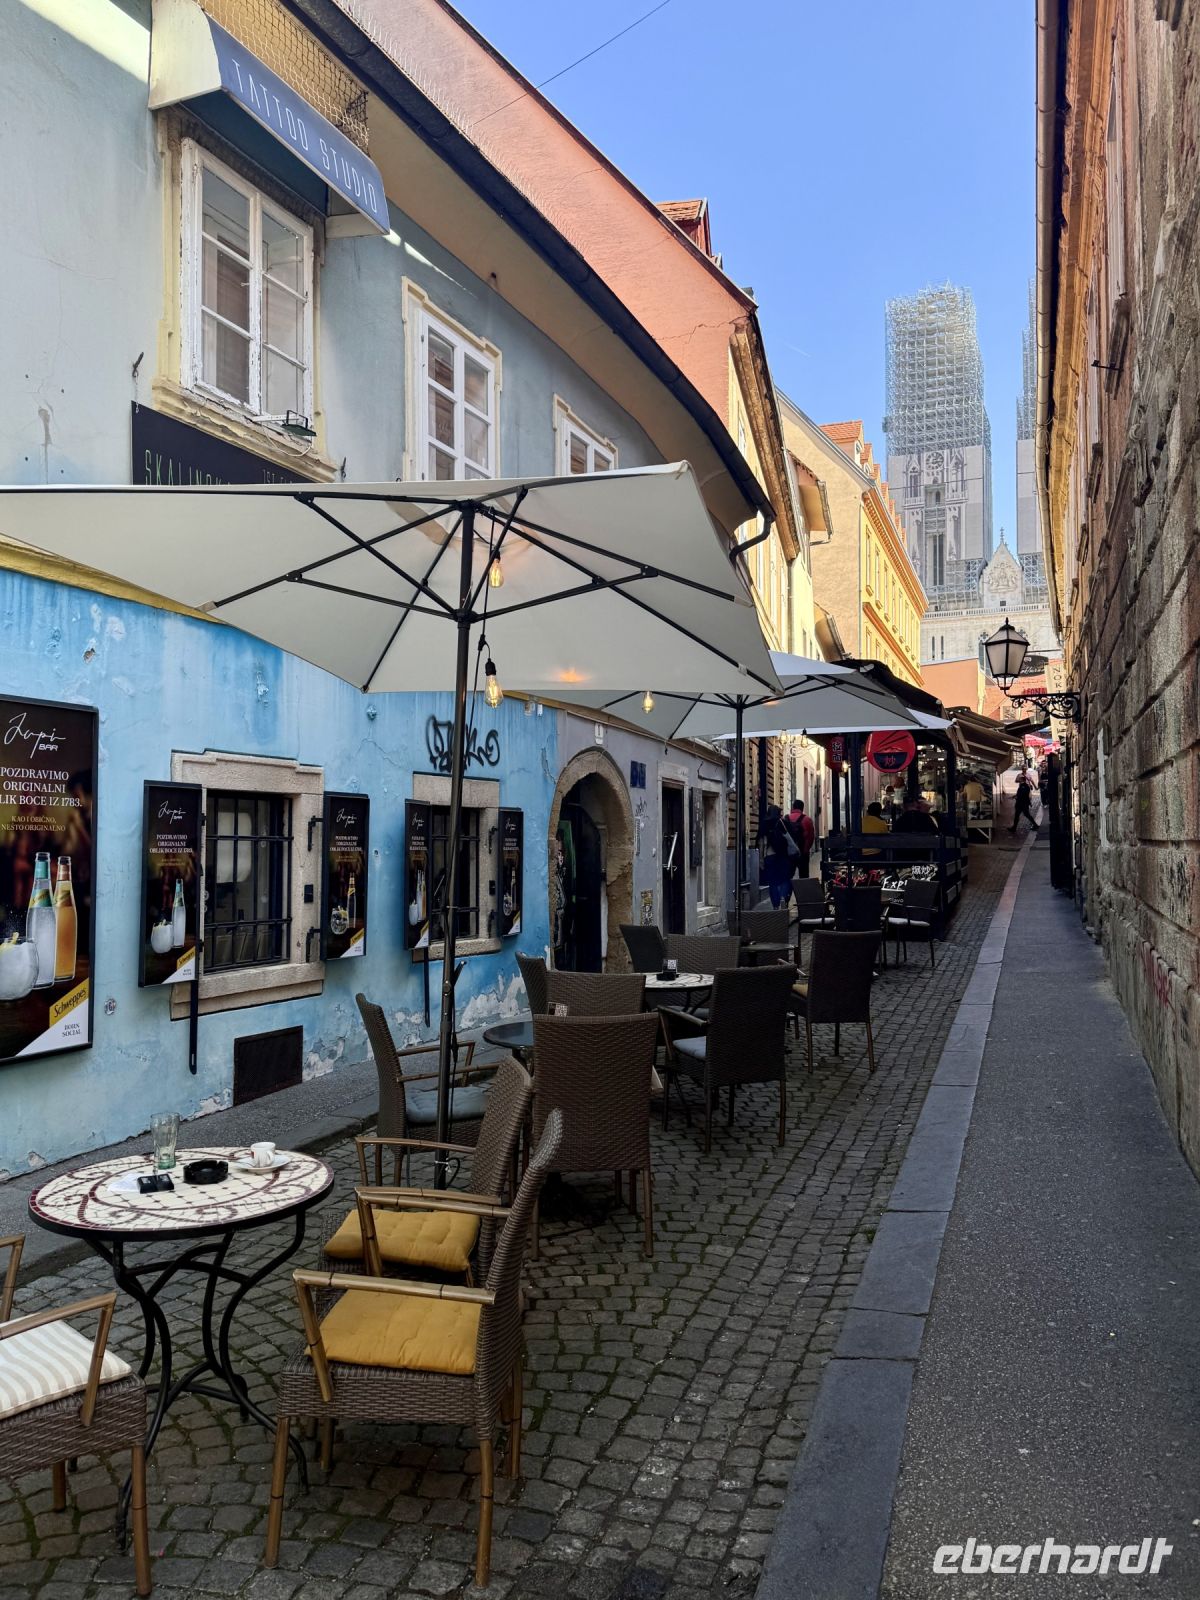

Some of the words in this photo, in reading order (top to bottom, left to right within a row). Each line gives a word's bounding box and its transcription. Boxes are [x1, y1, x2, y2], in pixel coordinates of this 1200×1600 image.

[231, 58, 309, 151] TATTOO
[319, 138, 378, 213] STUDIO
[145, 449, 231, 485] SKALIN
[38, 743, 59, 752] BAR
[0, 766, 69, 781] POZDRAVIMO
[3, 780, 66, 794] ORIGINALNI
[19, 795, 47, 806] BOCE
[49, 796, 59, 806] IZ
[61, 797, 83, 807] 1783.
[11, 815, 26, 823] KAO
[53, 988, 87, 1018] Schweppes
